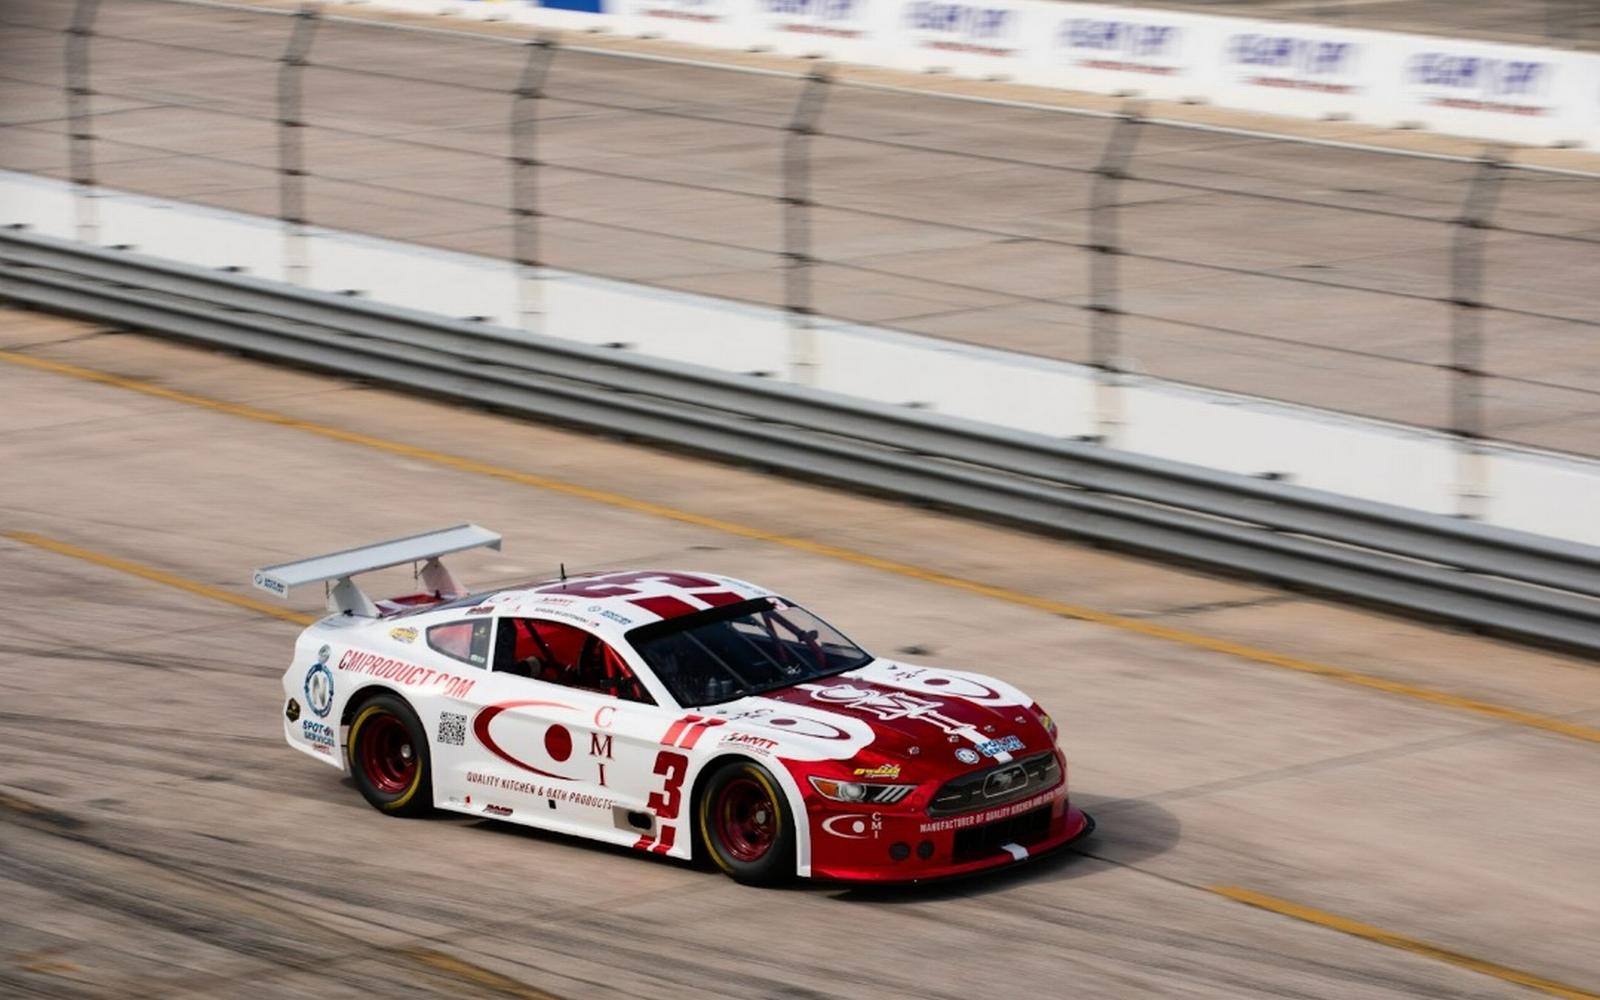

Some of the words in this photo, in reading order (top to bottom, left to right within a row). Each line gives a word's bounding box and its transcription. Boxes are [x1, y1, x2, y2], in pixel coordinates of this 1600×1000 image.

[338, 649, 476, 698] CMIPRODUCTCOM
[466, 771, 500, 785] QUALITY
[501, 778, 536, 795] KITCHEN
[537, 785, 544, 797] &
[546, 787, 568, 801] BATH
[568, 790, 615, 811] PRODUCTS
[647, 750, 689, 820] 3
[919, 815, 975, 833] MANUFACTURER
[985, 805, 1011, 822] QUALITY
